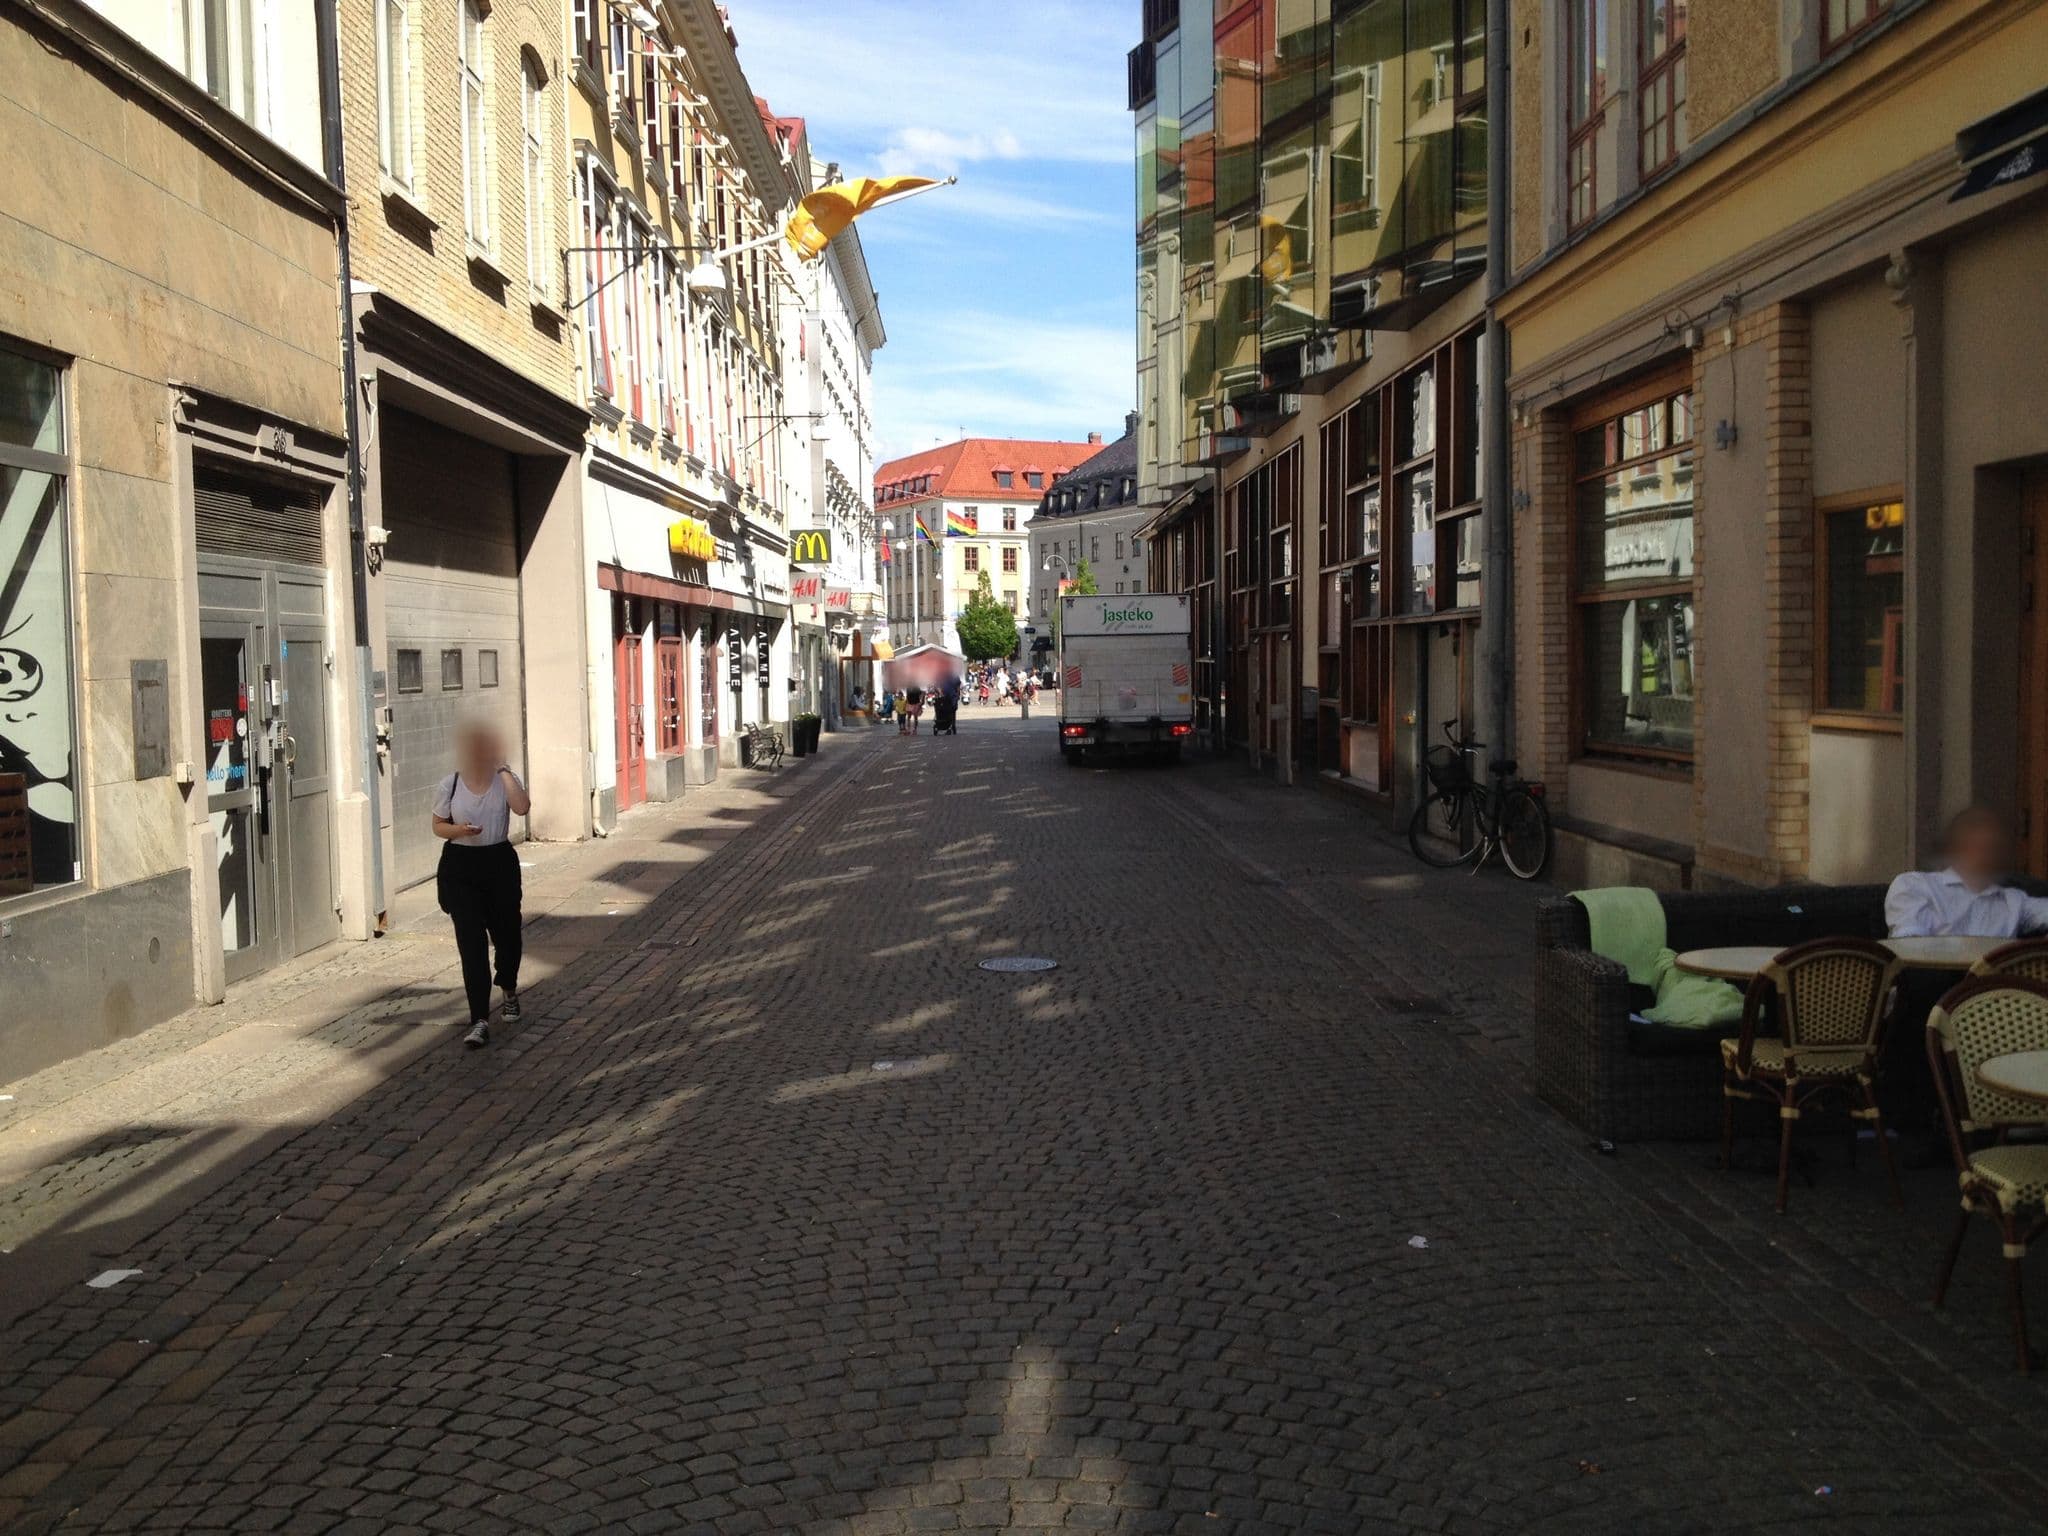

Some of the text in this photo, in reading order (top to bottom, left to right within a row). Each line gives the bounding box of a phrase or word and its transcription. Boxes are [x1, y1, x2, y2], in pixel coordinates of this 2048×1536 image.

[1102, 602, 1154, 625] jasteko
[729, 617, 741, 687] ALAME
[757, 622, 768, 683] ALAME
